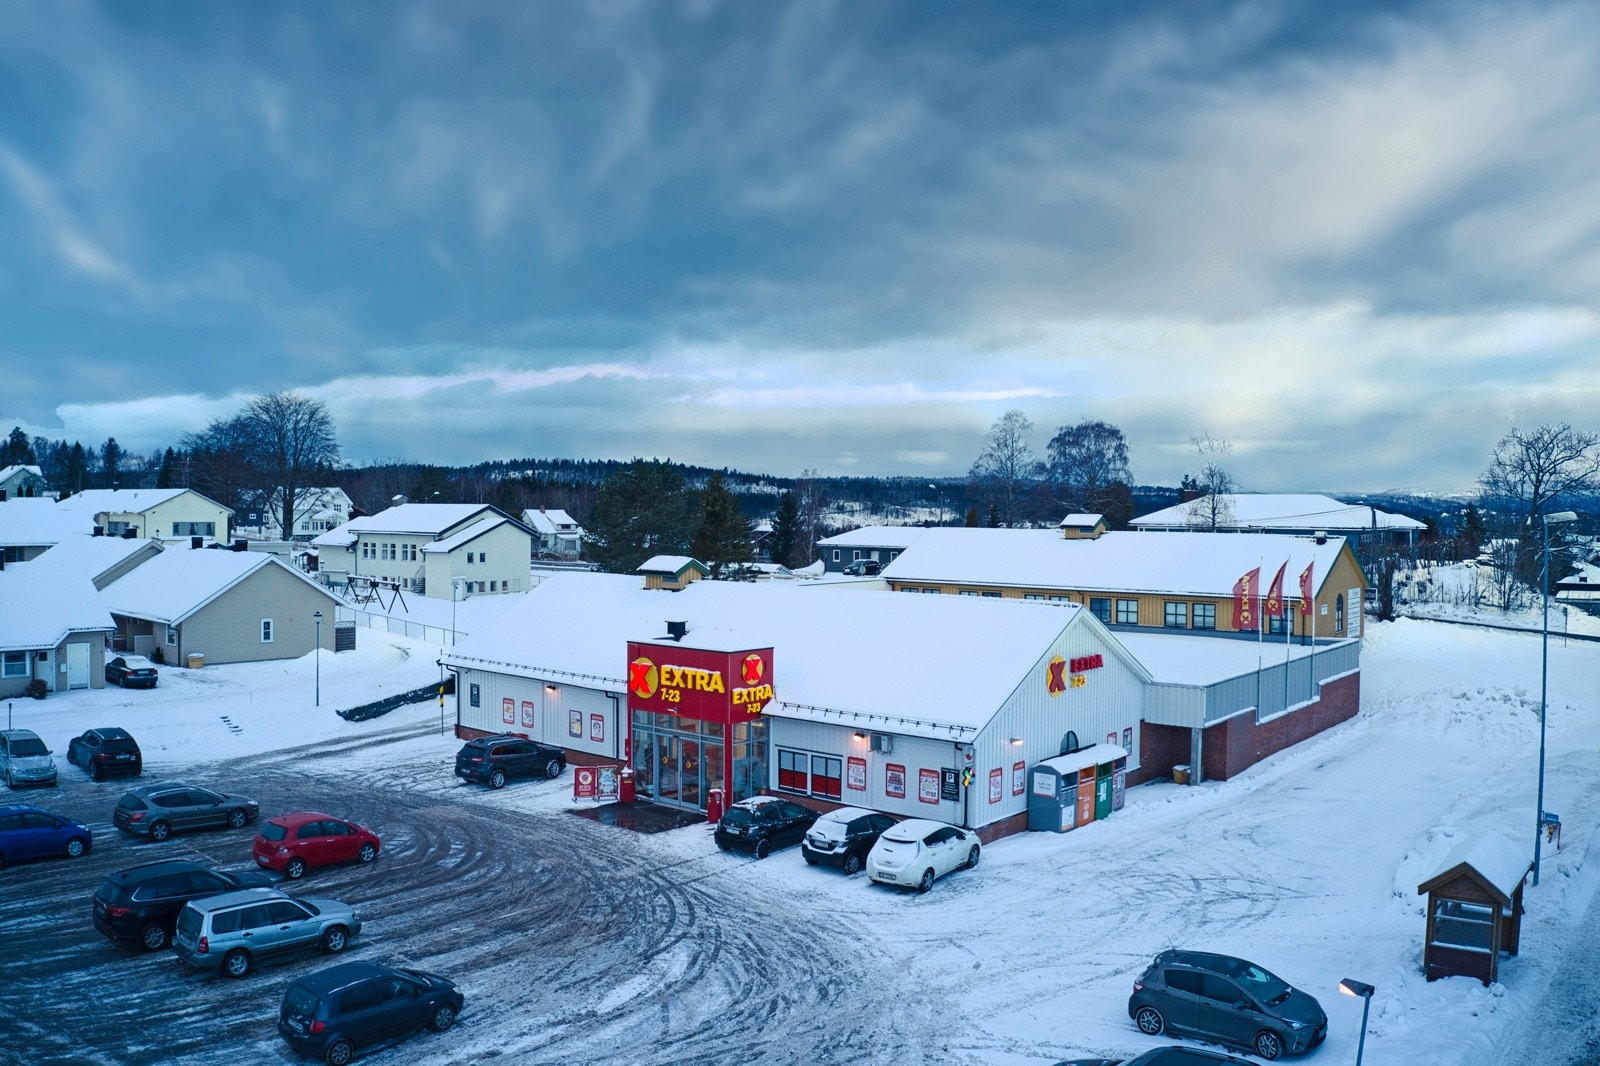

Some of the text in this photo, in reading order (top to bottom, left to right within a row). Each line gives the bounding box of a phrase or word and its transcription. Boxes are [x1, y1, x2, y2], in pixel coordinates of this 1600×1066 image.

[1241, 575, 1250, 610] EXTRA
[1070, 654, 1104, 673] EXTRA
[660, 665, 725, 693] EXTRA
[661, 688, 681, 703] 7-23
[732, 685, 773, 704] EXTRA
[746, 703, 761, 714] 7-23
